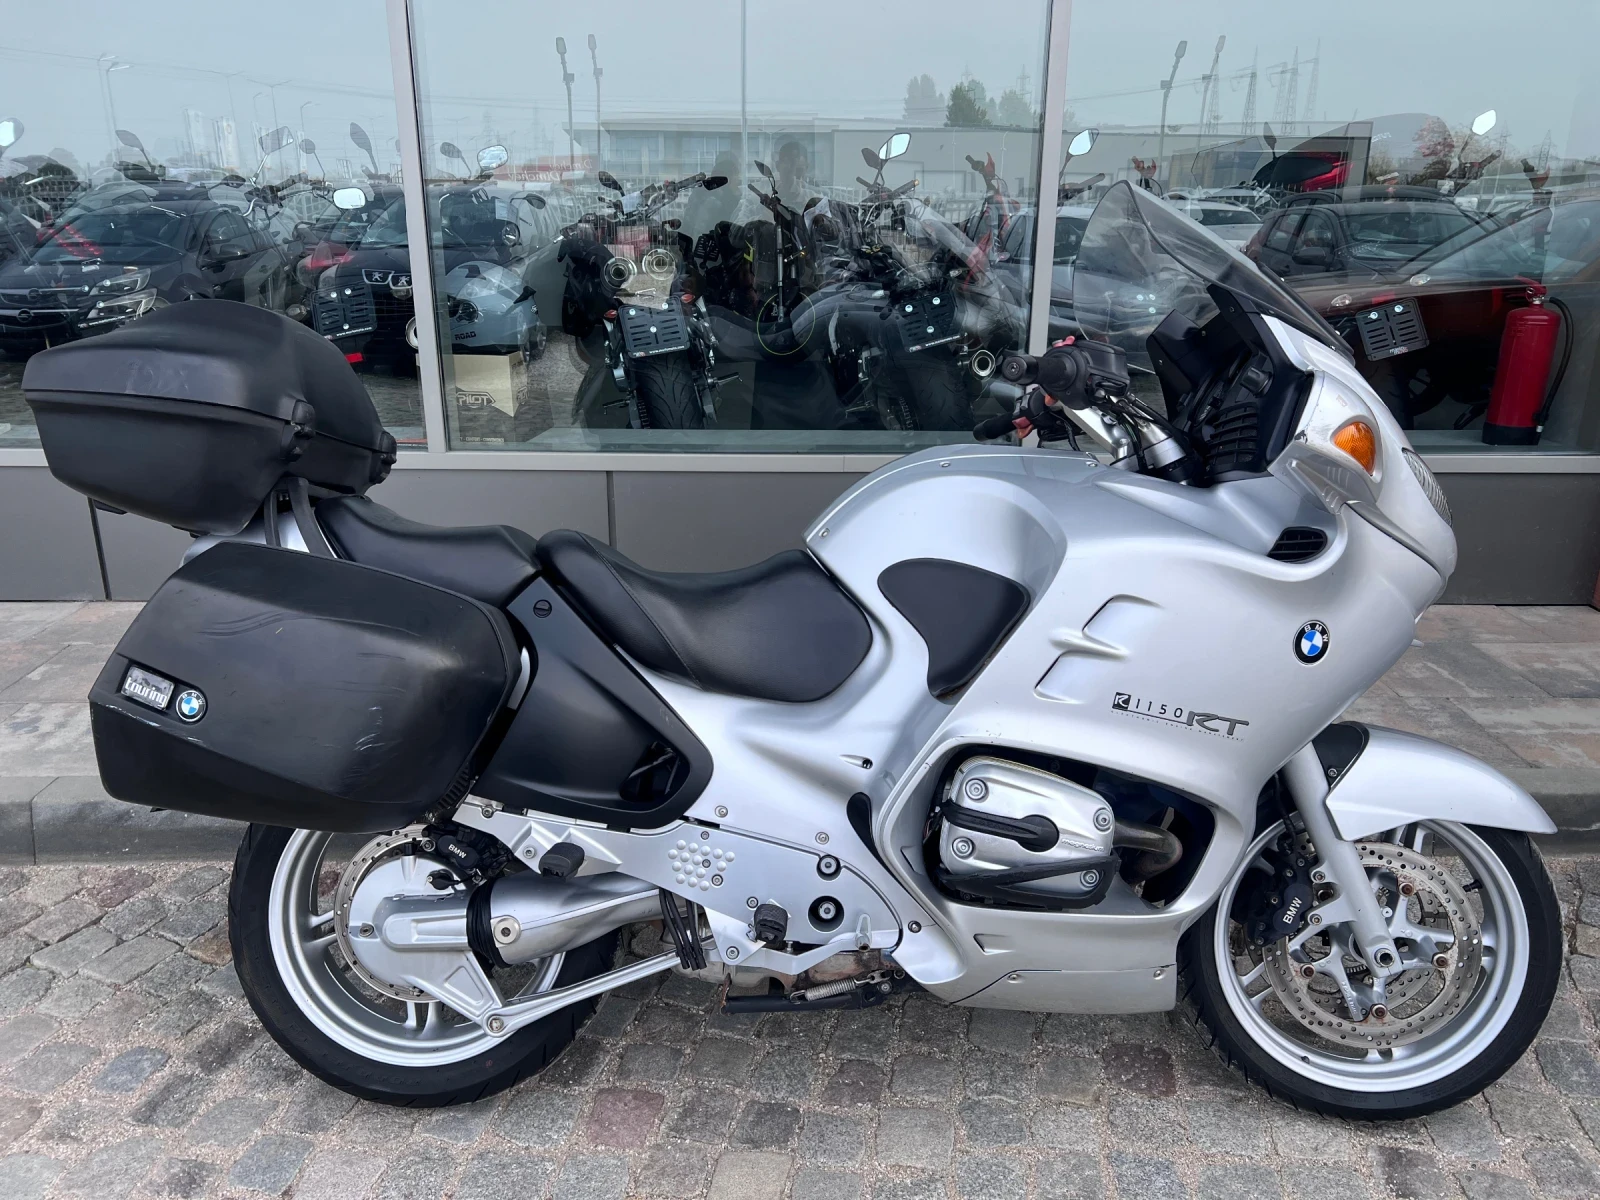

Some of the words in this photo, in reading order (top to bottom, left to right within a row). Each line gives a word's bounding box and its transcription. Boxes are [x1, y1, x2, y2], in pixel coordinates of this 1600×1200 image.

[1304, 623, 1329, 642] BMW
[124, 676, 168, 708] touring
[1136, 698, 1184, 718] 1150
[1186, 710, 1250, 736] RT
[448, 843, 467, 859] BMW
[1282, 896, 1303, 924] BMW
